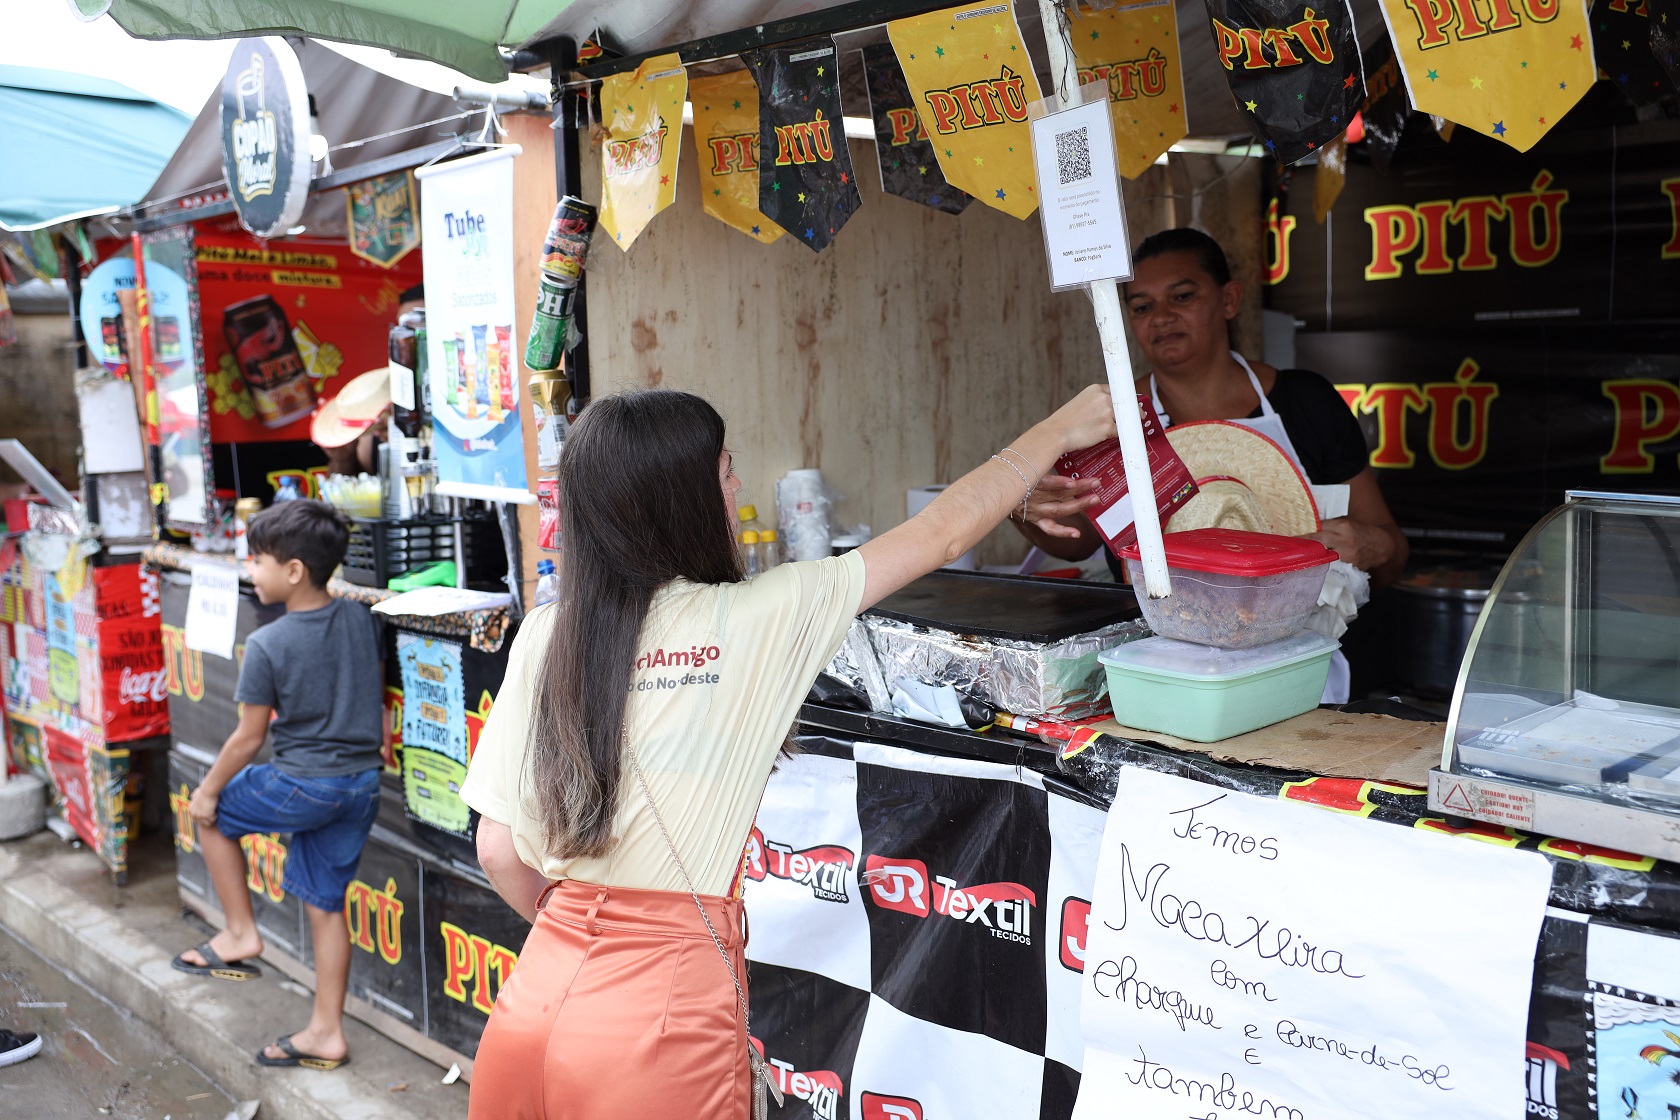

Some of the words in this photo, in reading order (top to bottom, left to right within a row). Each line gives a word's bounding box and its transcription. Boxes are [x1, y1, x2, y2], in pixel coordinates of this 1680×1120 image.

[1212, 8, 1337, 71] PITÚ
[924, 64, 1029, 135] PITÚ
[775, 108, 834, 167] PITÚ
[444, 209, 485, 238] Tube
[1363, 169, 1570, 281] PITÚ
[637, 679, 654, 692] do
[1478, 807, 1504, 818] CUIDADO!
[1505, 812, 1531, 823] CALIENTE
[1480, 789, 1507, 800] CUIDADO!
[1508, 793, 1529, 804] QUENTE
[1485, 798, 1511, 809] CAUTION!
[1512, 804, 1524, 812] HOT
[1170, 794, 1278, 860] Temos
[768, 842, 847, 894] Textil
[814, 887, 847, 902] TECIDOS
[873, 865, 926, 910] JR
[936, 875, 1031, 936] Textil
[989, 927, 1032, 946] TECIDOS
